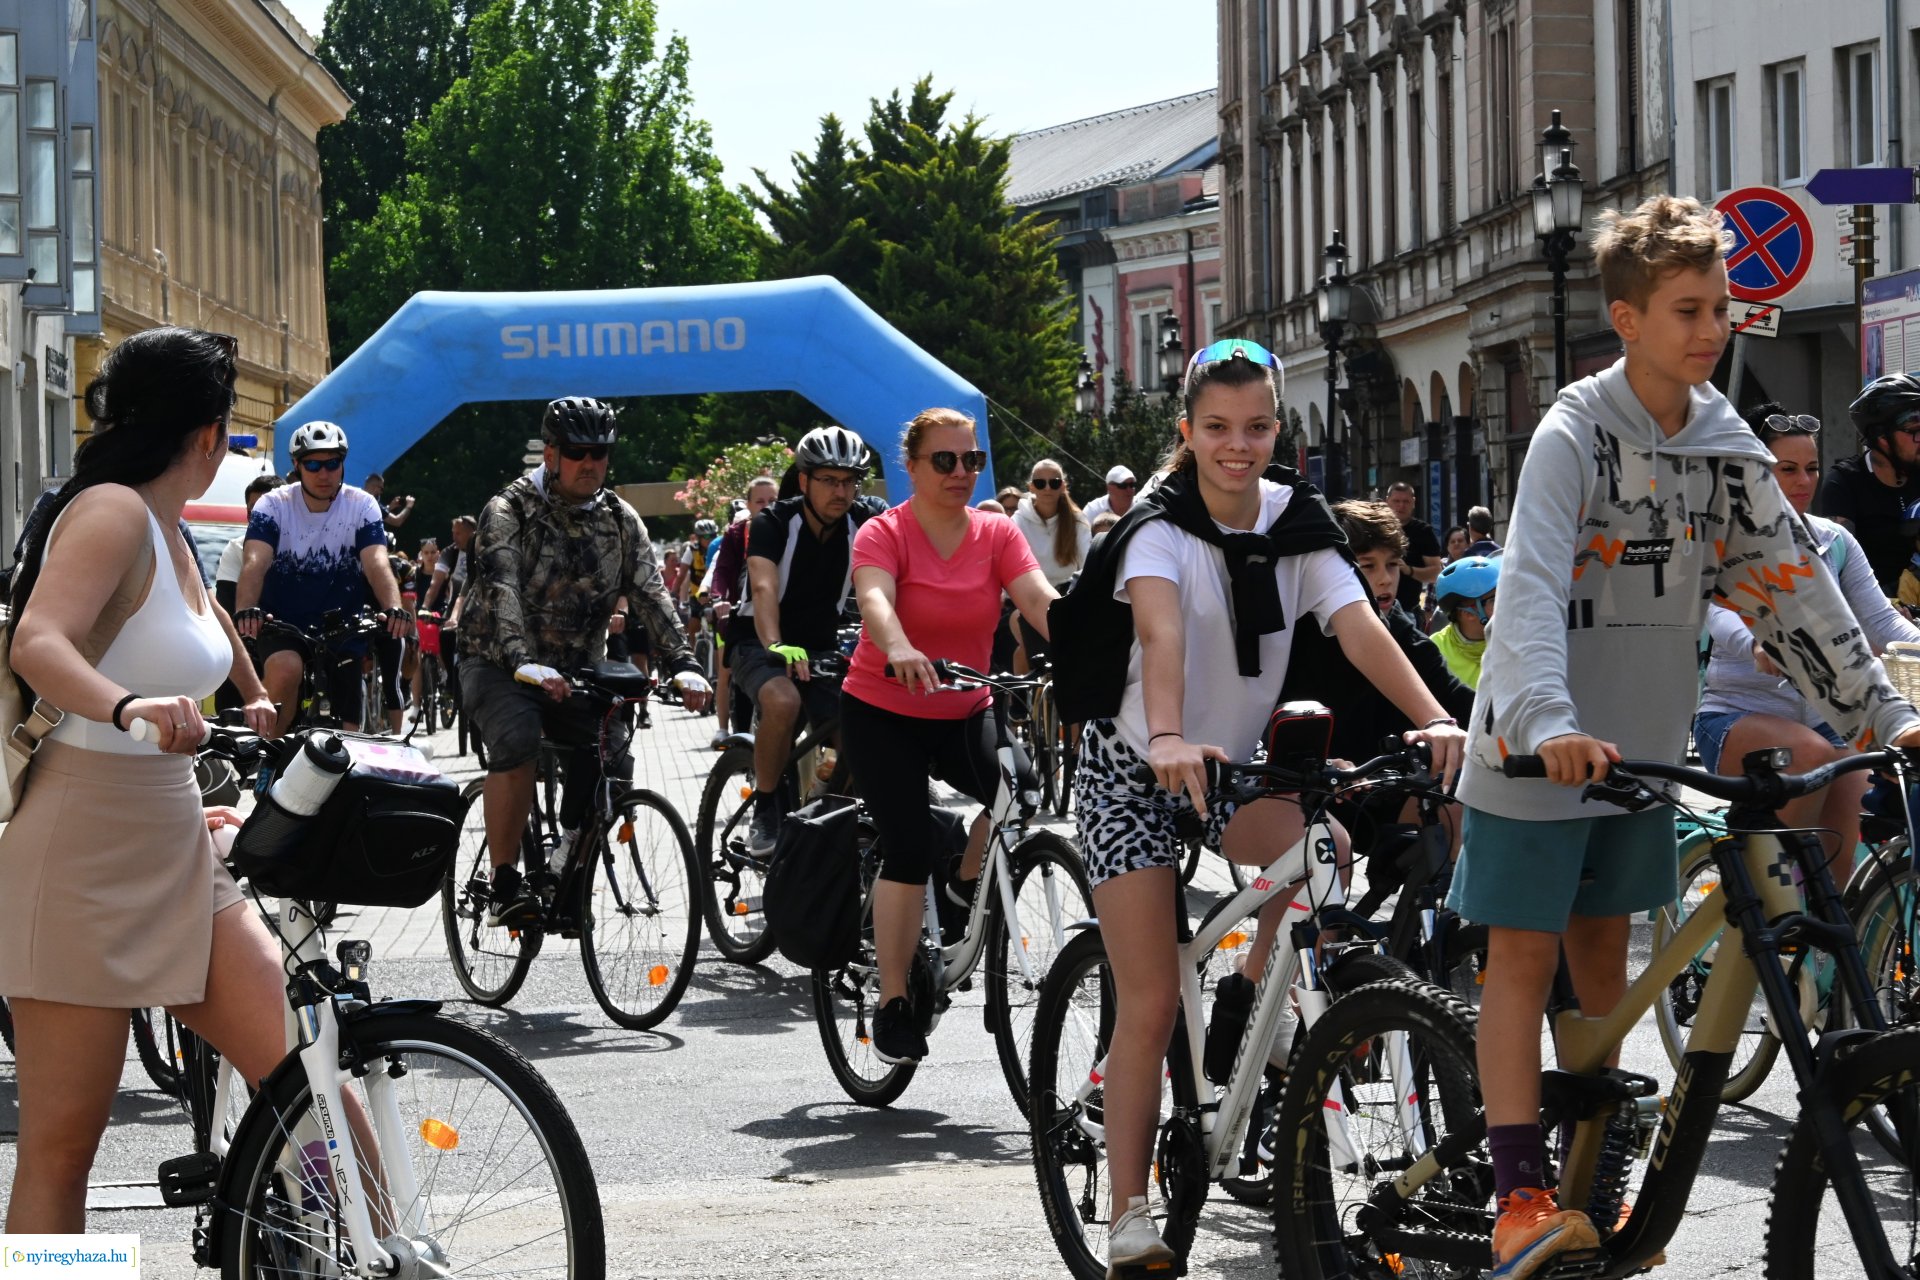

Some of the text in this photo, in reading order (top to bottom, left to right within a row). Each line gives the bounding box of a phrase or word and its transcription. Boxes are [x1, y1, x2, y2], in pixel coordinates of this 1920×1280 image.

[501, 316, 746, 360] SHIMANO
[411, 844, 440, 860] KLS
[1651, 1057, 1695, 1171] CUBE
